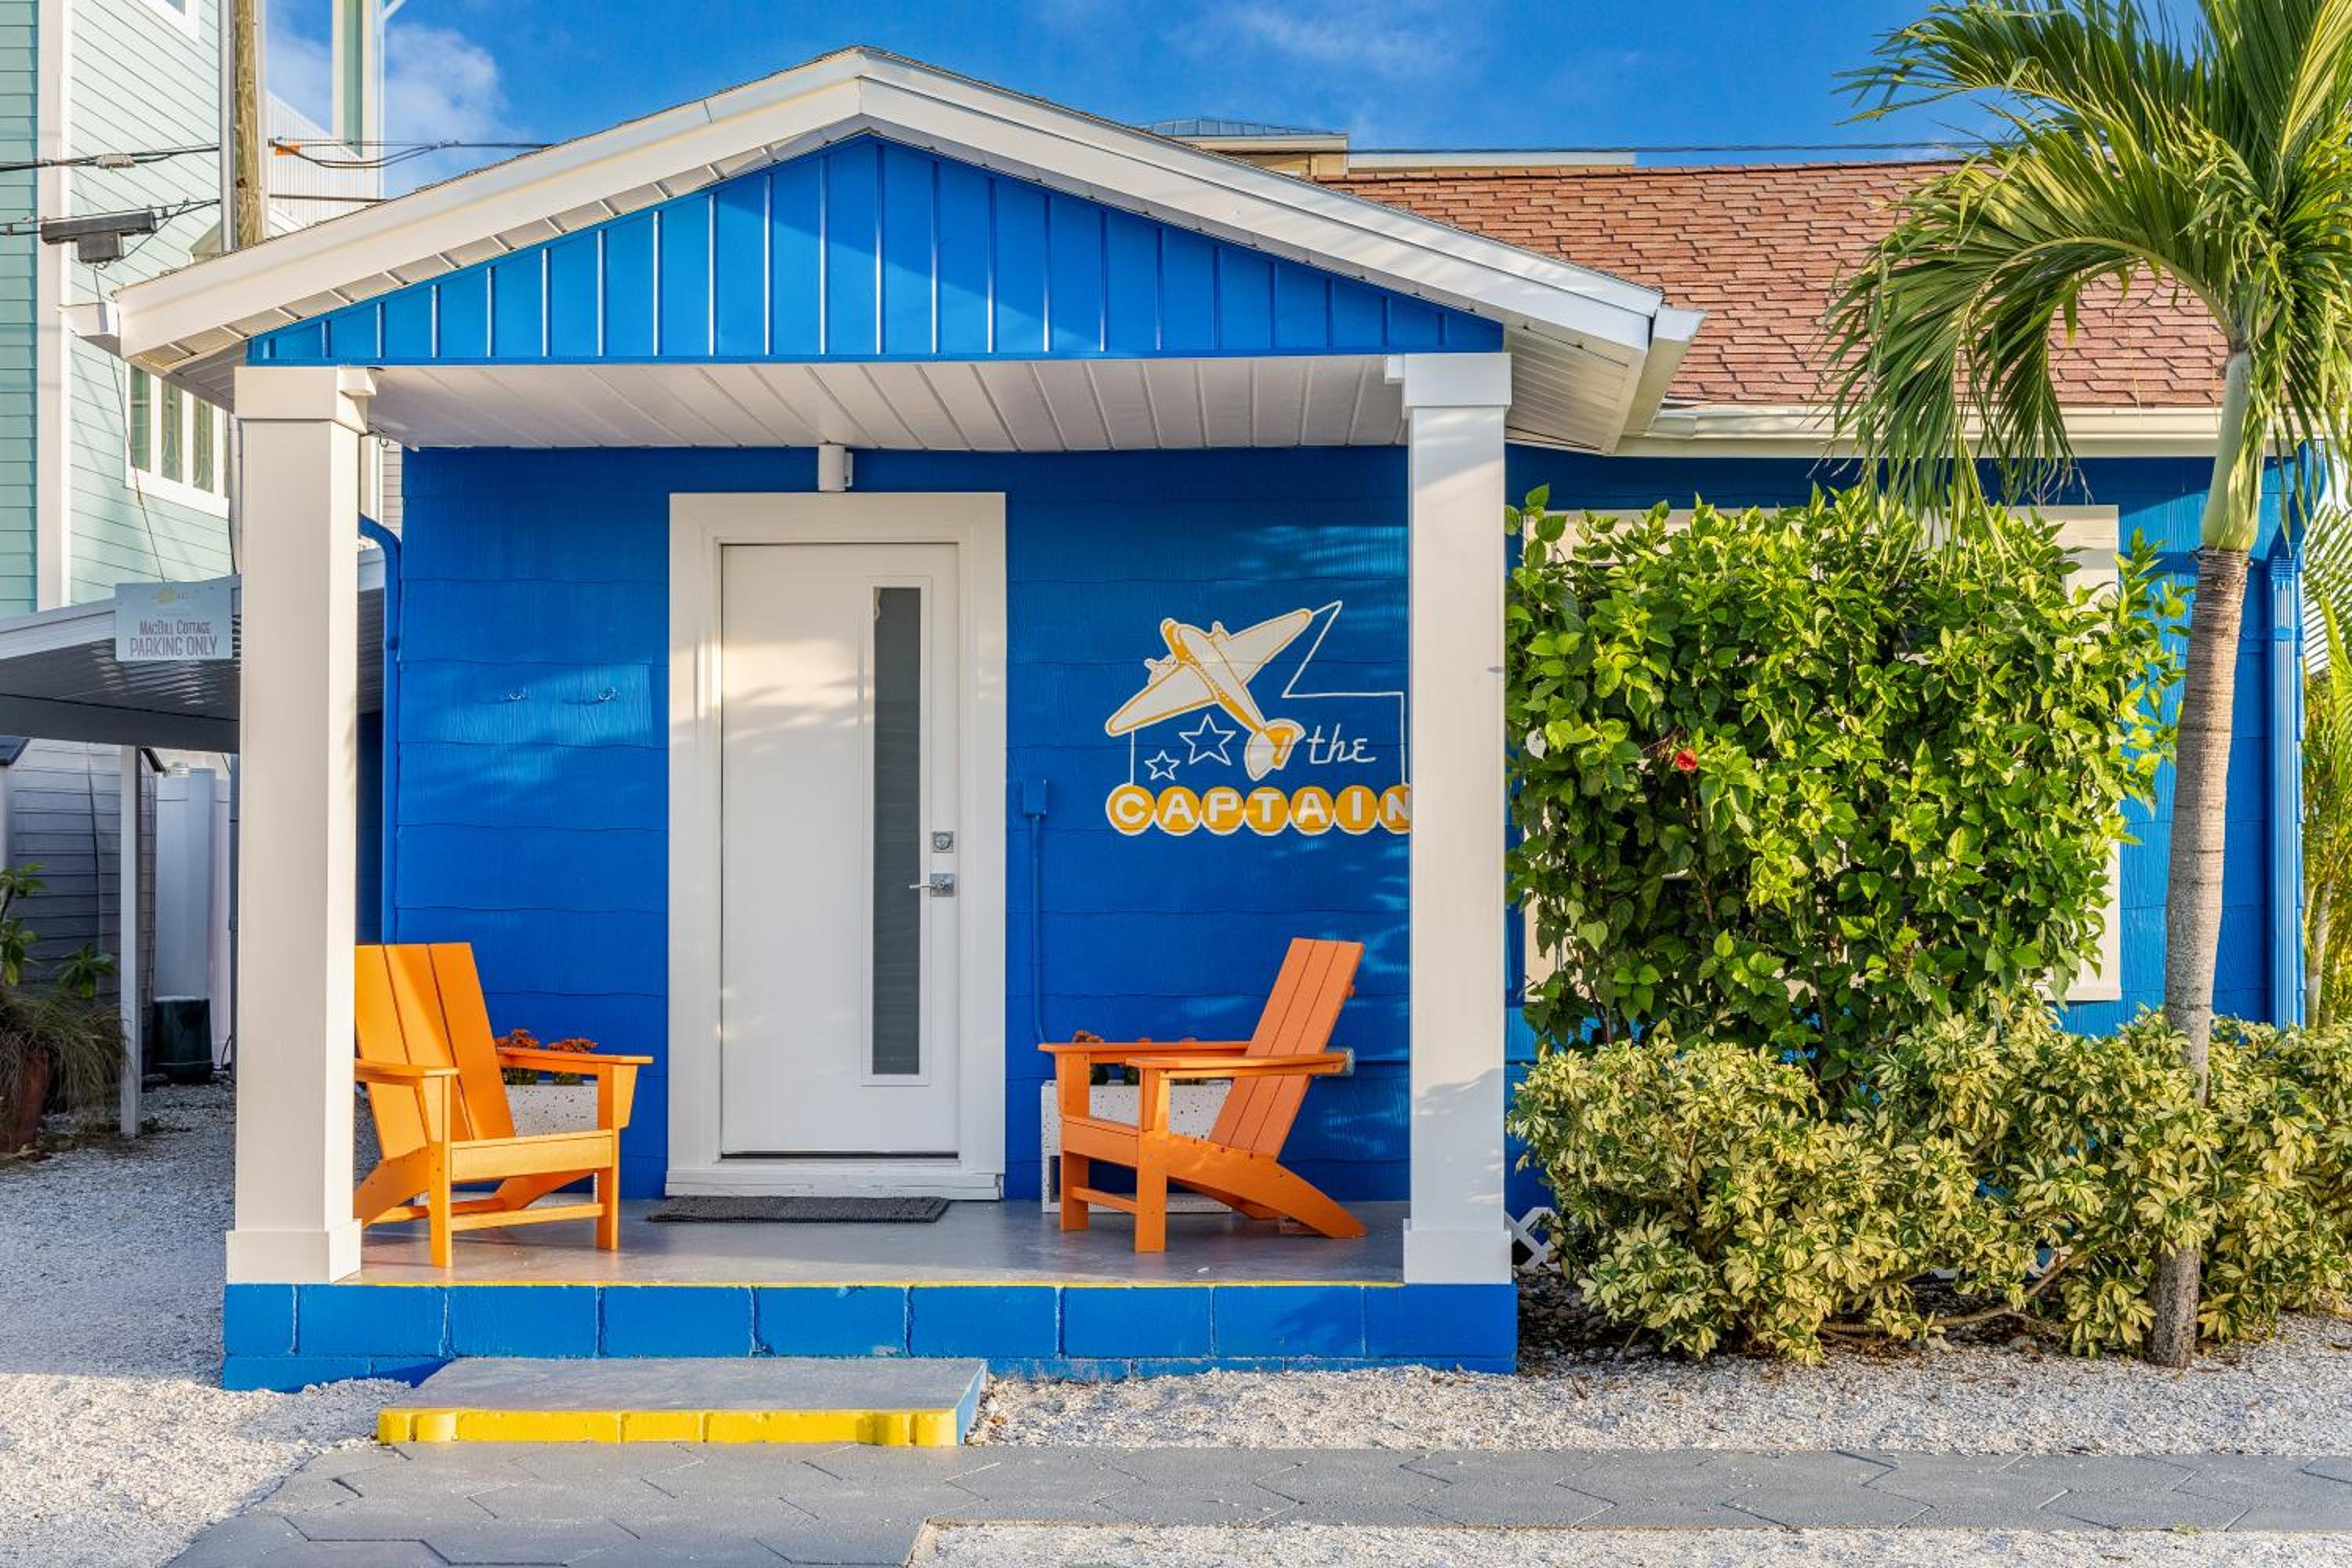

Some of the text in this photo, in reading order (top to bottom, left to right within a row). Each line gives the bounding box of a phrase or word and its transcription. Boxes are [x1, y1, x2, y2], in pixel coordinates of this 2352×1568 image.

[176, 619, 211, 634] COTTAGE
[130, 636, 217, 656] PARKING ONLY
[1307, 723, 1376, 764] the
[1115, 792, 1411, 824] CAPTAIN
